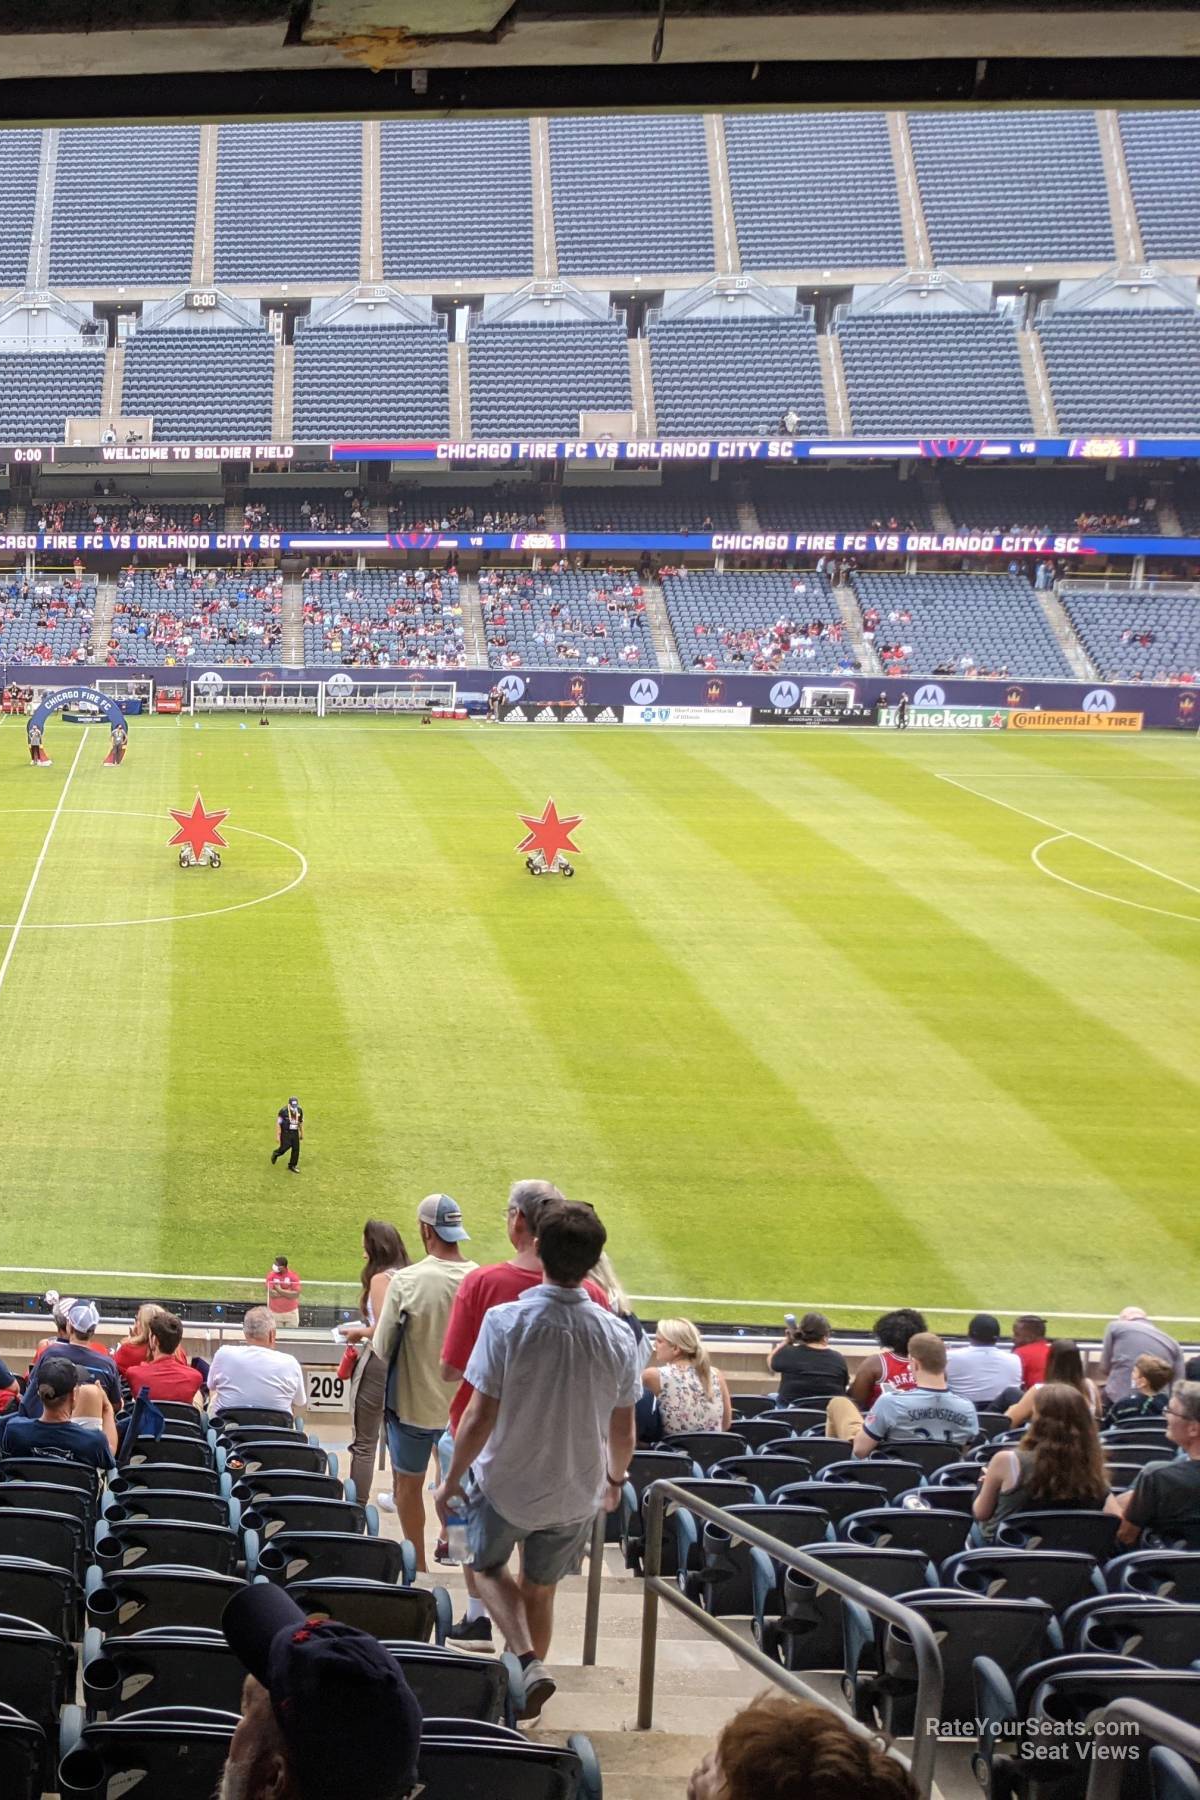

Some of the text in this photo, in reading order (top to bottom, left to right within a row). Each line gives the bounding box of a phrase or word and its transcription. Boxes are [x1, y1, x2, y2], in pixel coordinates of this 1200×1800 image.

[193, 294, 215, 306] 0:00
[14, 448, 42, 462] 0:00
[102, 446, 294, 460] WELCOME TO SOLDIER FIELD
[436, 441, 794, 458] CHICAGO FIRE FC VS ORLANDO CITY SC
[43, 536, 78, 549] FIRE
[84, 536, 104, 549] FC
[110, 536, 131, 549] VS
[136, 536, 210, 549] ORLANDO
[216, 536, 252, 549] CITY
[259, 536, 281, 549] SC
[712, 536, 1080, 552] CHICAGO FIRE FC VS ORLANDO CITY SC
[44, 691, 112, 710] CHICAGO FIRE FC
[774, 708, 872, 717] BLACKSTONE
[1012, 712, 1137, 728] Continental TIRE
[310, 1376, 345, 1399] 209
